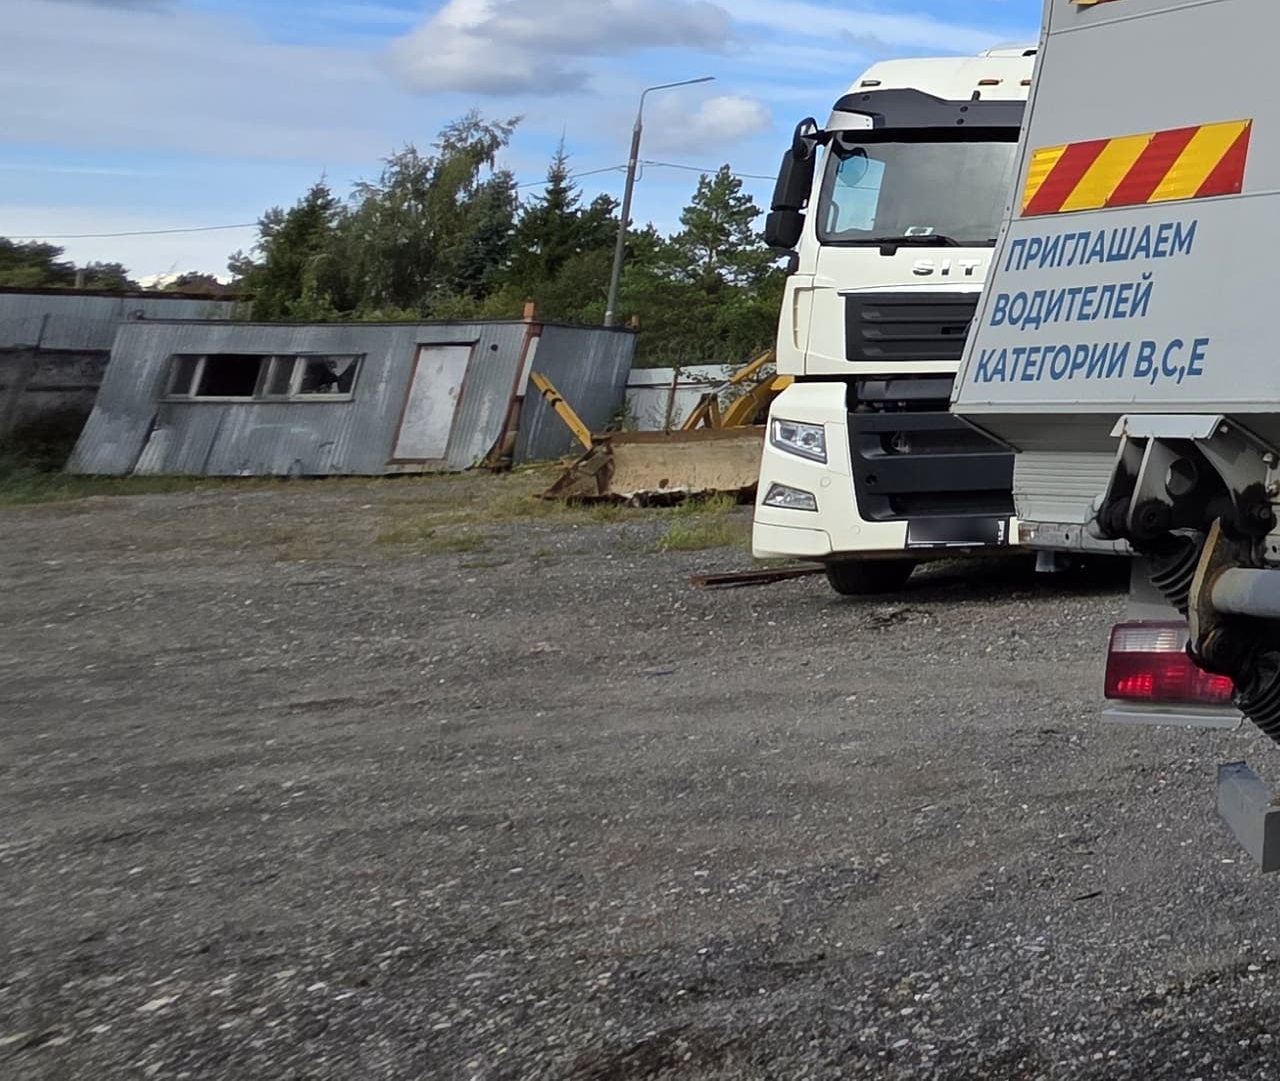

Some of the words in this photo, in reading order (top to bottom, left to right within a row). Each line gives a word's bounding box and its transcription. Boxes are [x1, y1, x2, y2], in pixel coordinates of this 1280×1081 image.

[1004, 219, 1198, 271] ПРИГЛАШАЕМ
[989, 272, 1154, 331] ВОДИТЕЛЕЙ
[973, 340, 1131, 384] КАТЕГОРИИ
